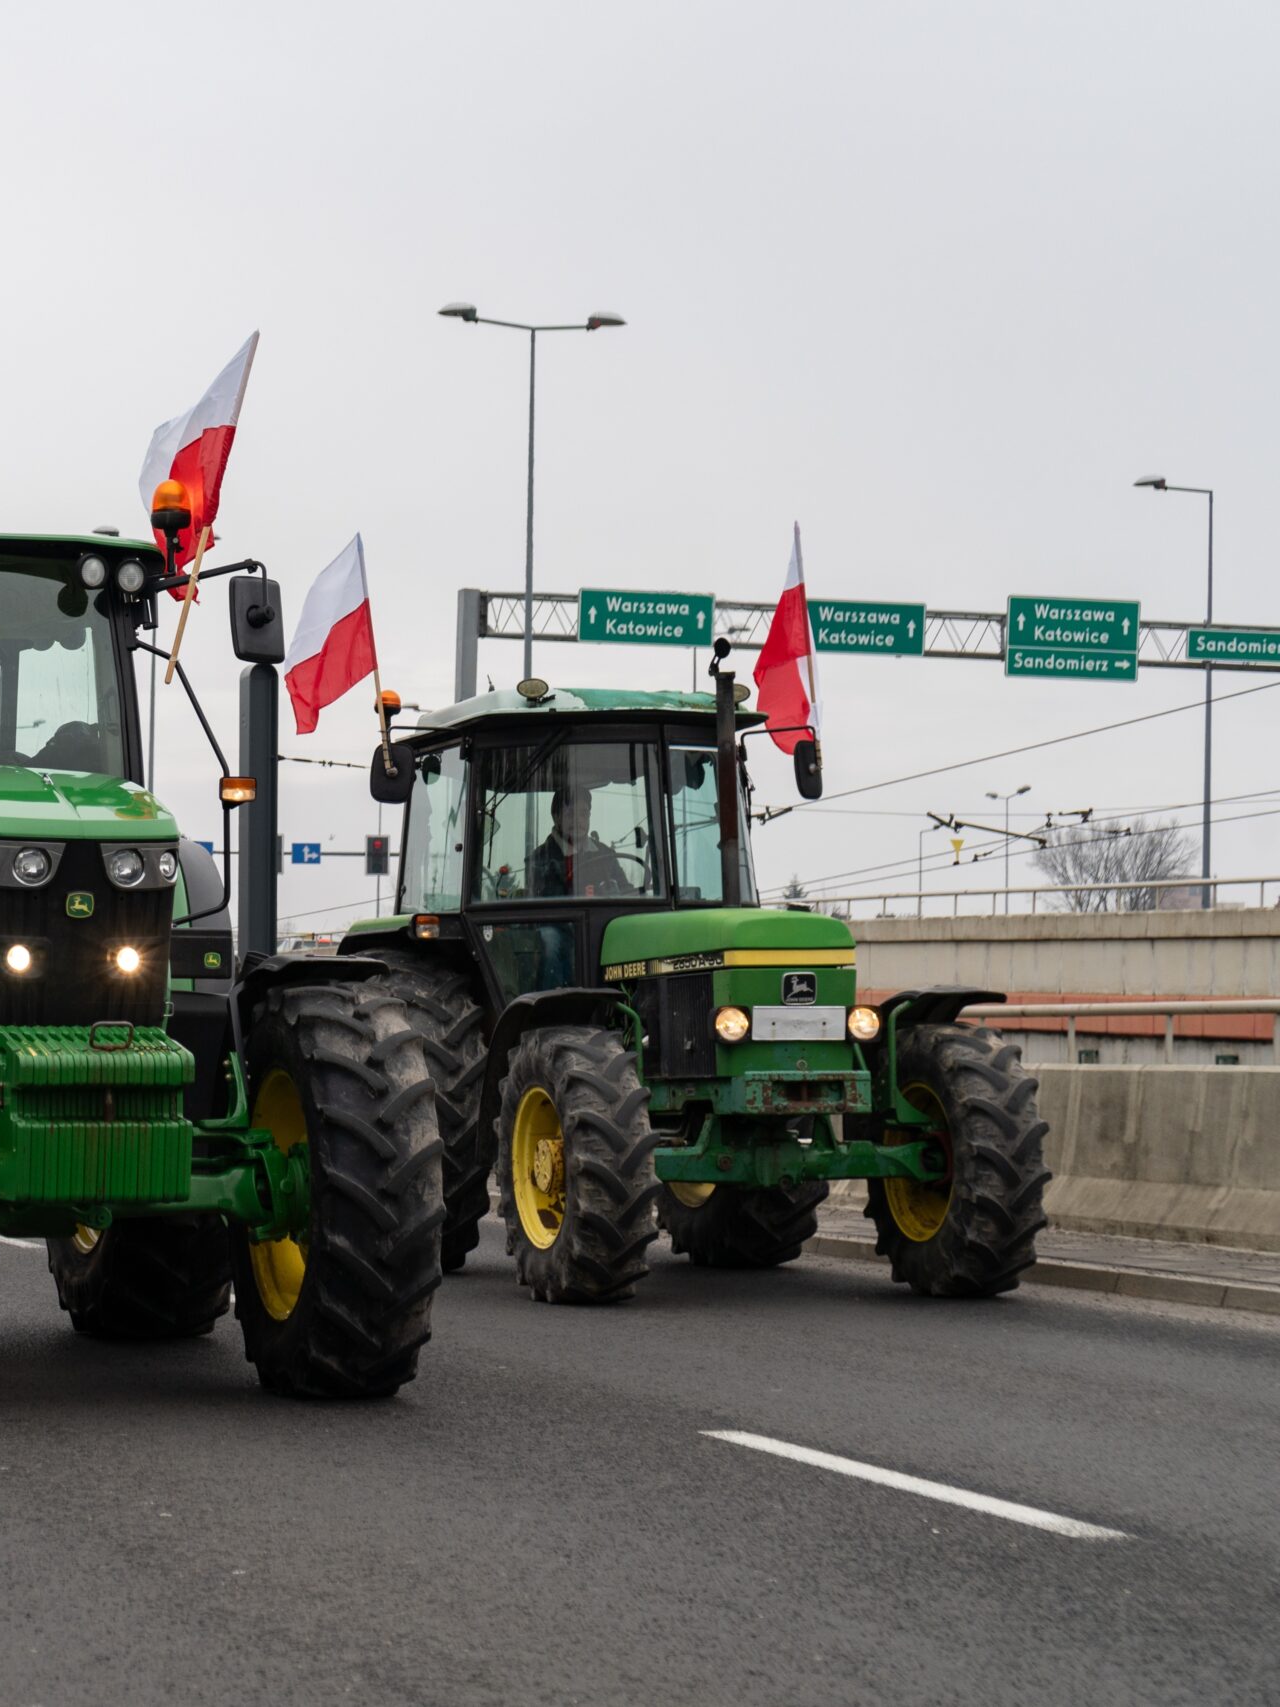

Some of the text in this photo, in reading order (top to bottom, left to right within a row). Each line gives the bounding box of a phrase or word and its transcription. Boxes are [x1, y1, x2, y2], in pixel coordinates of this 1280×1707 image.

[606, 596, 689, 615] Warszawa
[818, 606, 900, 624] Warszawa
[1034, 603, 1115, 622] Warszawa
[605, 619, 683, 637] Katowice
[818, 628, 895, 647] Katowice
[1034, 625, 1109, 644] Katowice
[1013, 652, 1109, 672] Sandomierz
[605, 966, 622, 980] JOHN
[624, 962, 646, 977] DEERE
